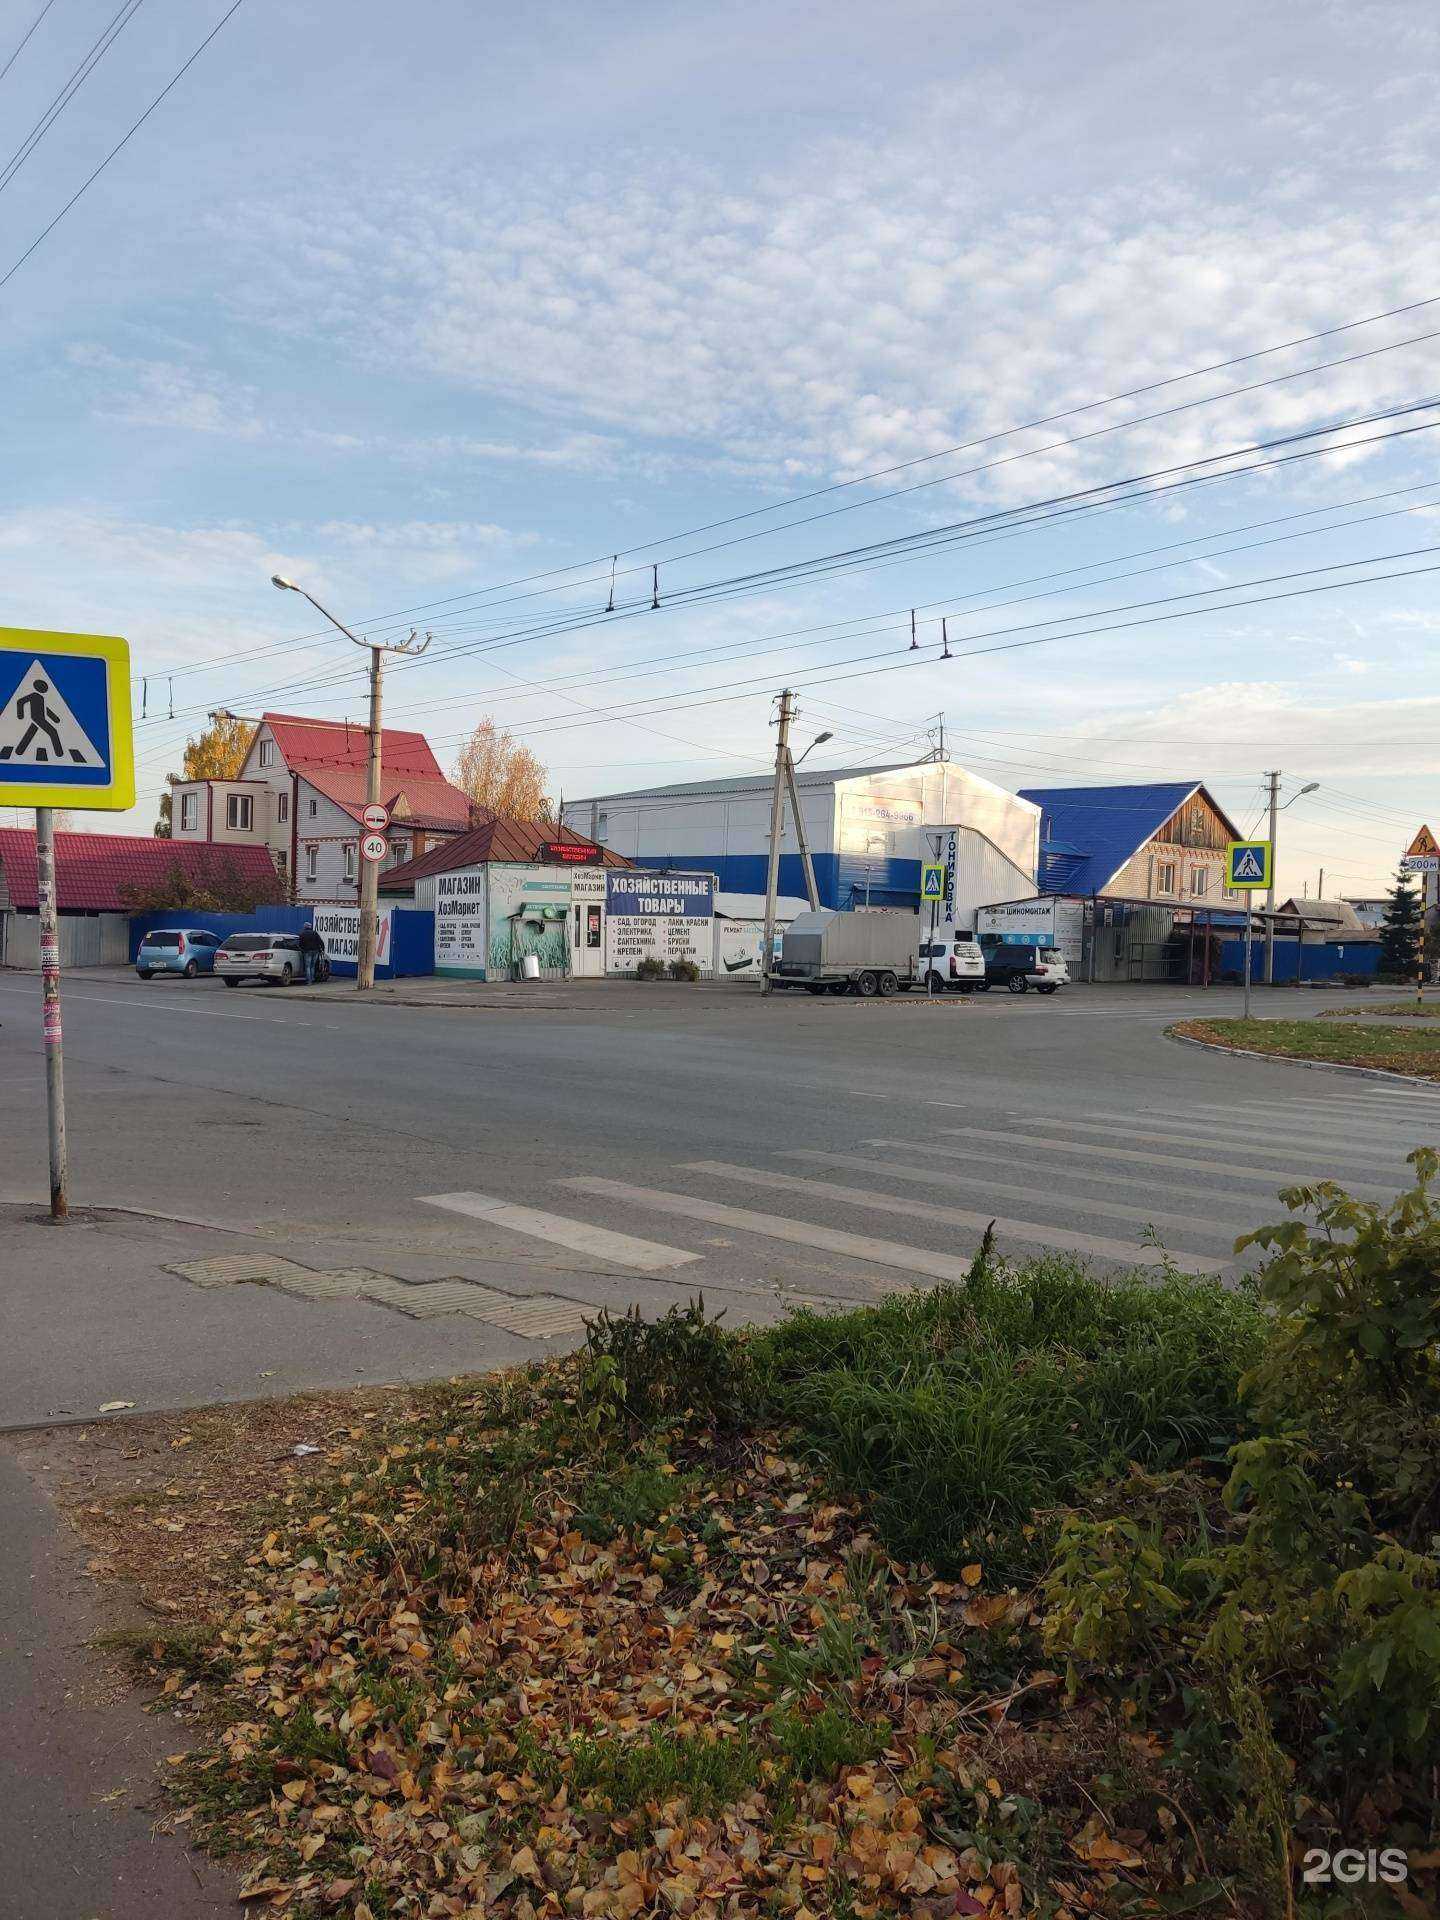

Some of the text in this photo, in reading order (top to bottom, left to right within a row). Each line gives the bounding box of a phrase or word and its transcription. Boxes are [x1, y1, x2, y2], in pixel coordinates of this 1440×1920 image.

[368, 842, 382, 853] 40
[574, 872, 605, 880] ХозМаркет
[945, 831, 956, 922] ТОНИРОВКА
[438, 877, 480, 895] МАГАЗИН
[574, 883, 605, 892] МАГАЗИН
[612, 876, 709, 895] ХОЗЯЙСТВЕННЫЕ
[438, 900, 480, 916] ХозМаркет
[638, 898, 684, 914] ТОВАРЫ
[1006, 907, 1051, 916] ШИНОМОНТАЖ
[314, 914, 380, 935] ХОЗЯЙСТВЕНЙ
[634, 919, 657, 927] ОГОРОД
[617, 928, 653, 936] ЭЛЕКТРИКА
[327, 938, 359, 957] МАГАЗИ
[617, 938, 656, 946] САНТЕХНИКА
[668, 947, 697, 955] ПЕРЧАТКИ
